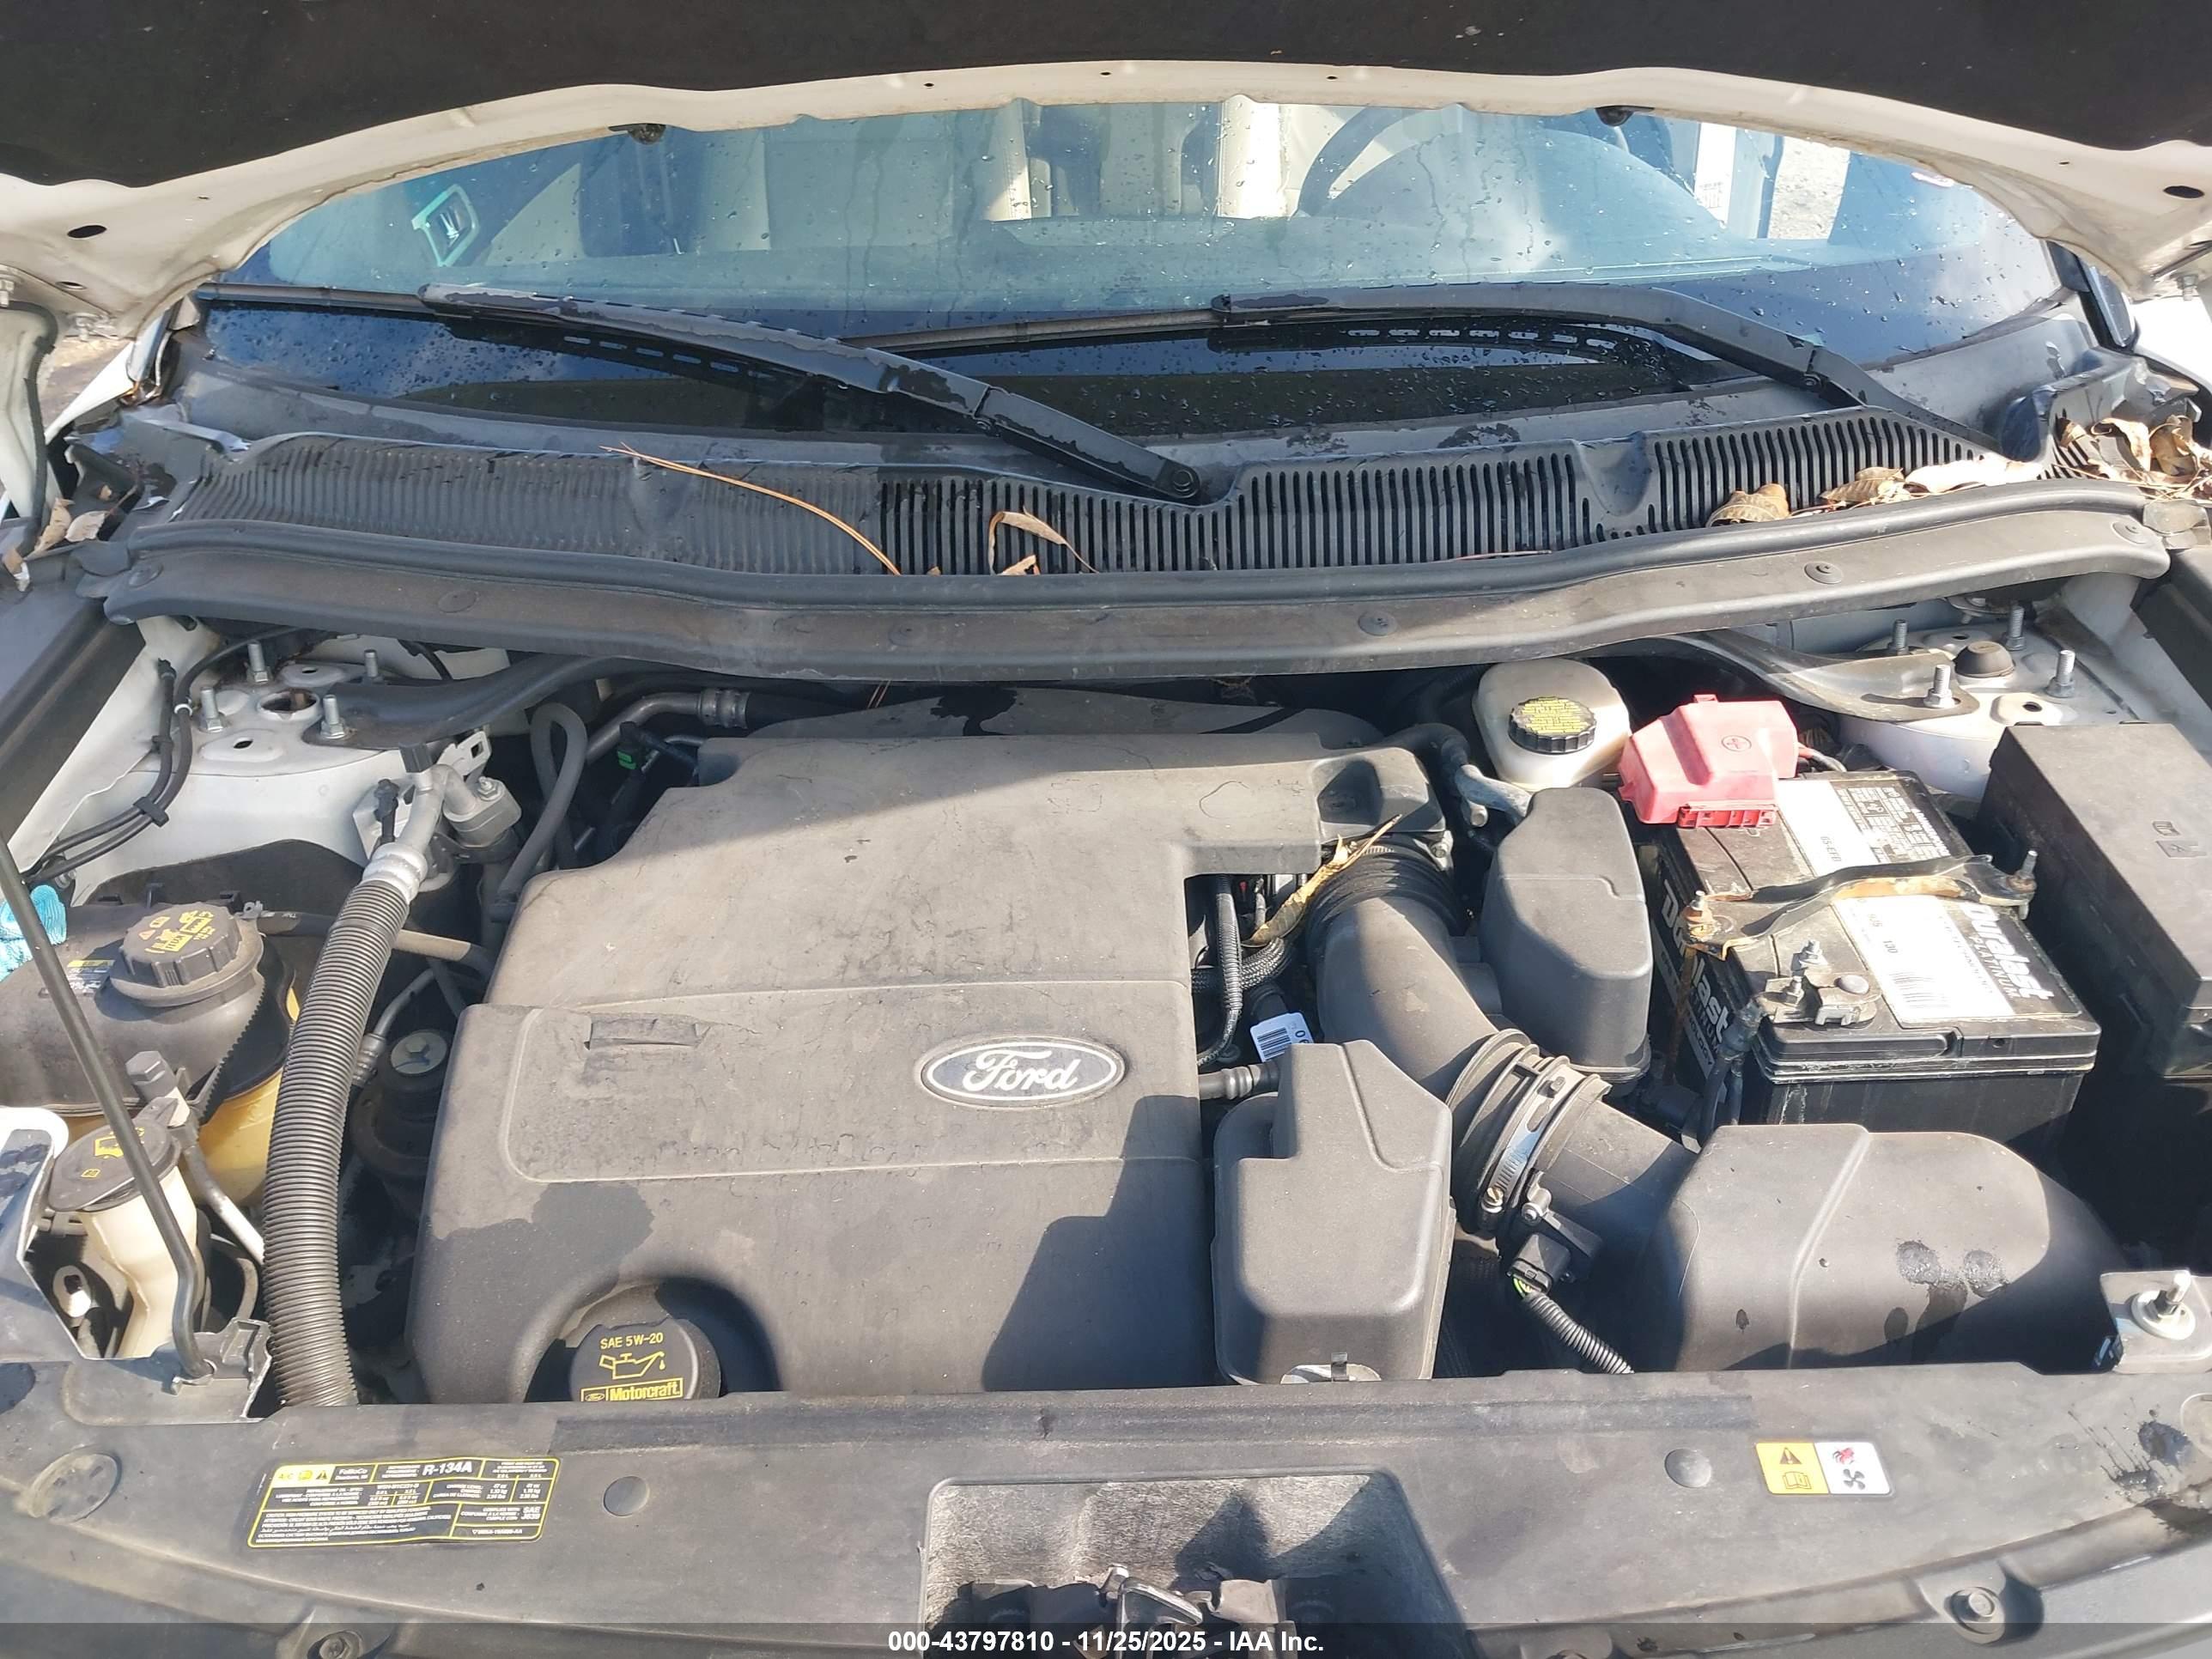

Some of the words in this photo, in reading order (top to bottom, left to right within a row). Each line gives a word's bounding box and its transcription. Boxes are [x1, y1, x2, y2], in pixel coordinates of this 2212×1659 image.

[1958, 900, 2055, 1001] Duralast
[1967, 933, 2021, 1000] PLATINUM
[962, 1048, 1082, 1092] Ford
[599, 1336, 623, 1350] SAE
[625, 1332, 664, 1347] 5W-20
[422, 1461, 473, 1476] R-134A
